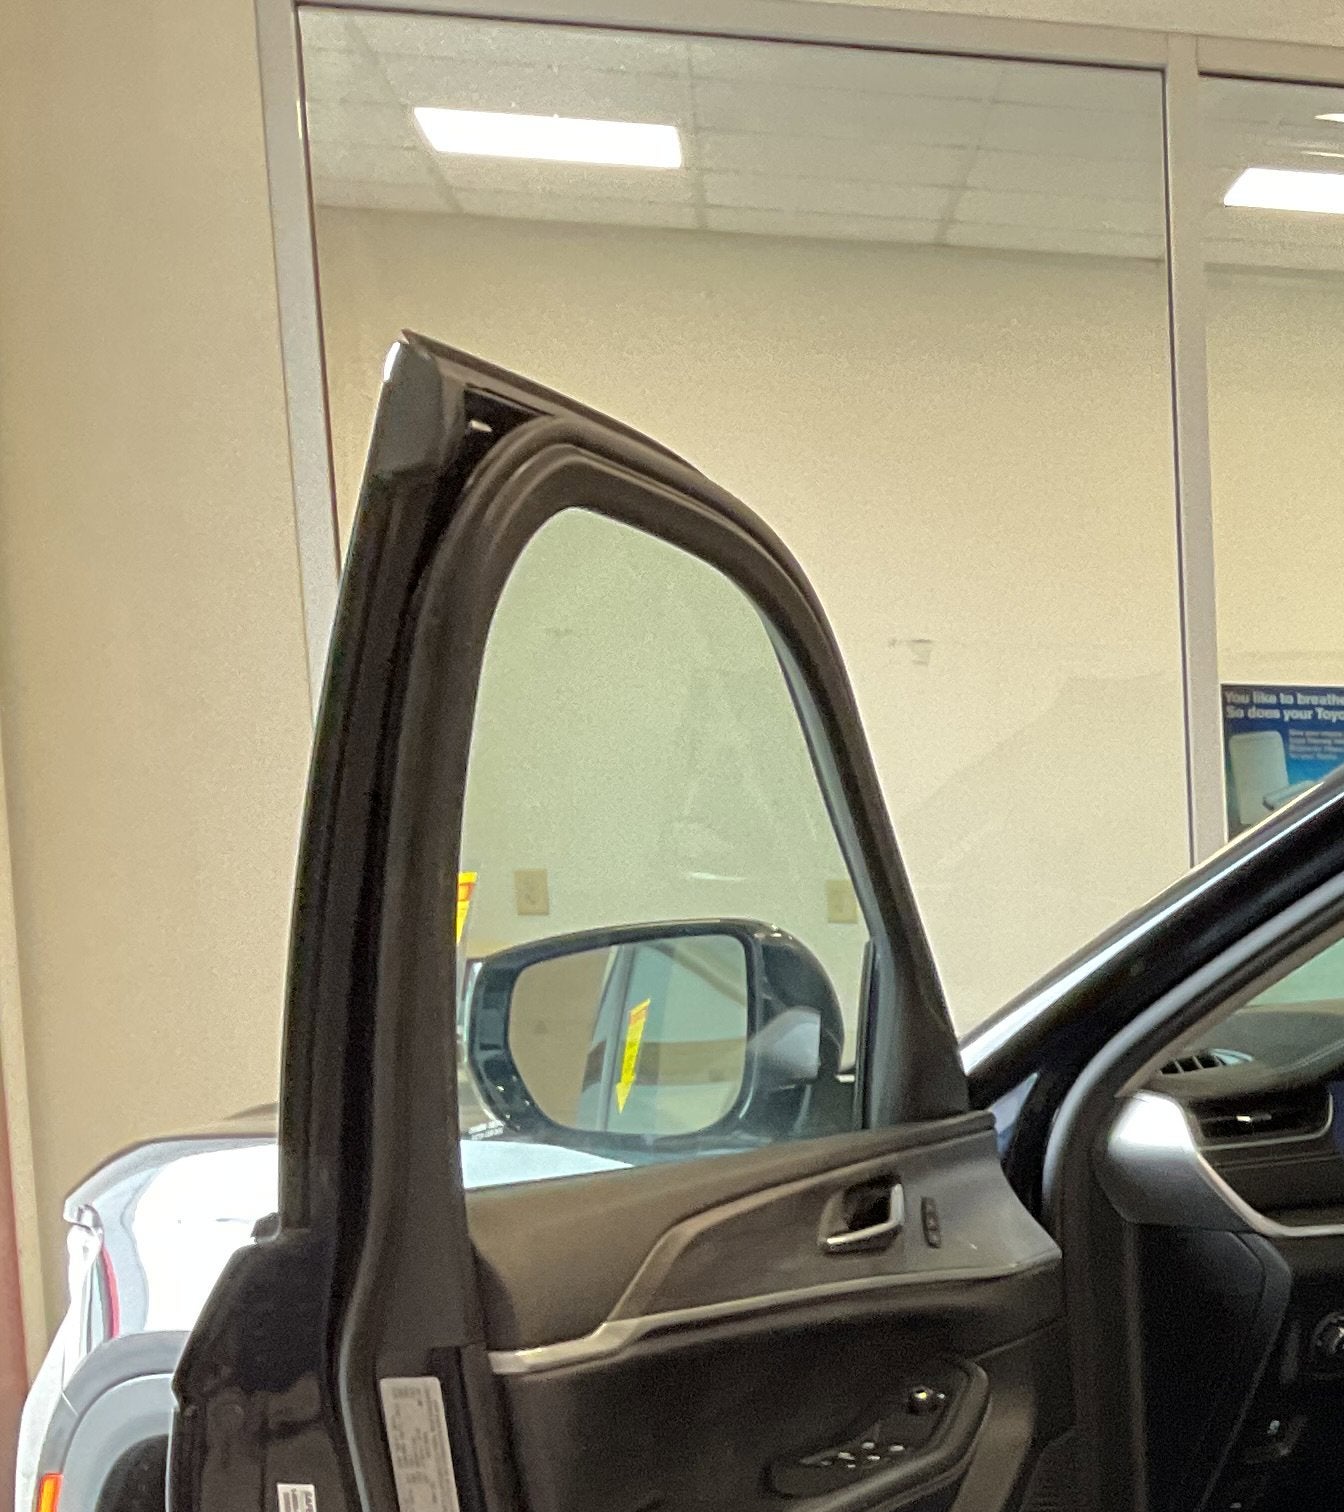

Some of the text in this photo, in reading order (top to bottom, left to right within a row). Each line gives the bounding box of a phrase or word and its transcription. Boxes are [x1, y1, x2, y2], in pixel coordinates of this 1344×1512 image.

[1280, 693, 1294, 704] to
[1248, 705, 1280, 719] does
[1283, 709, 1313, 722] your
